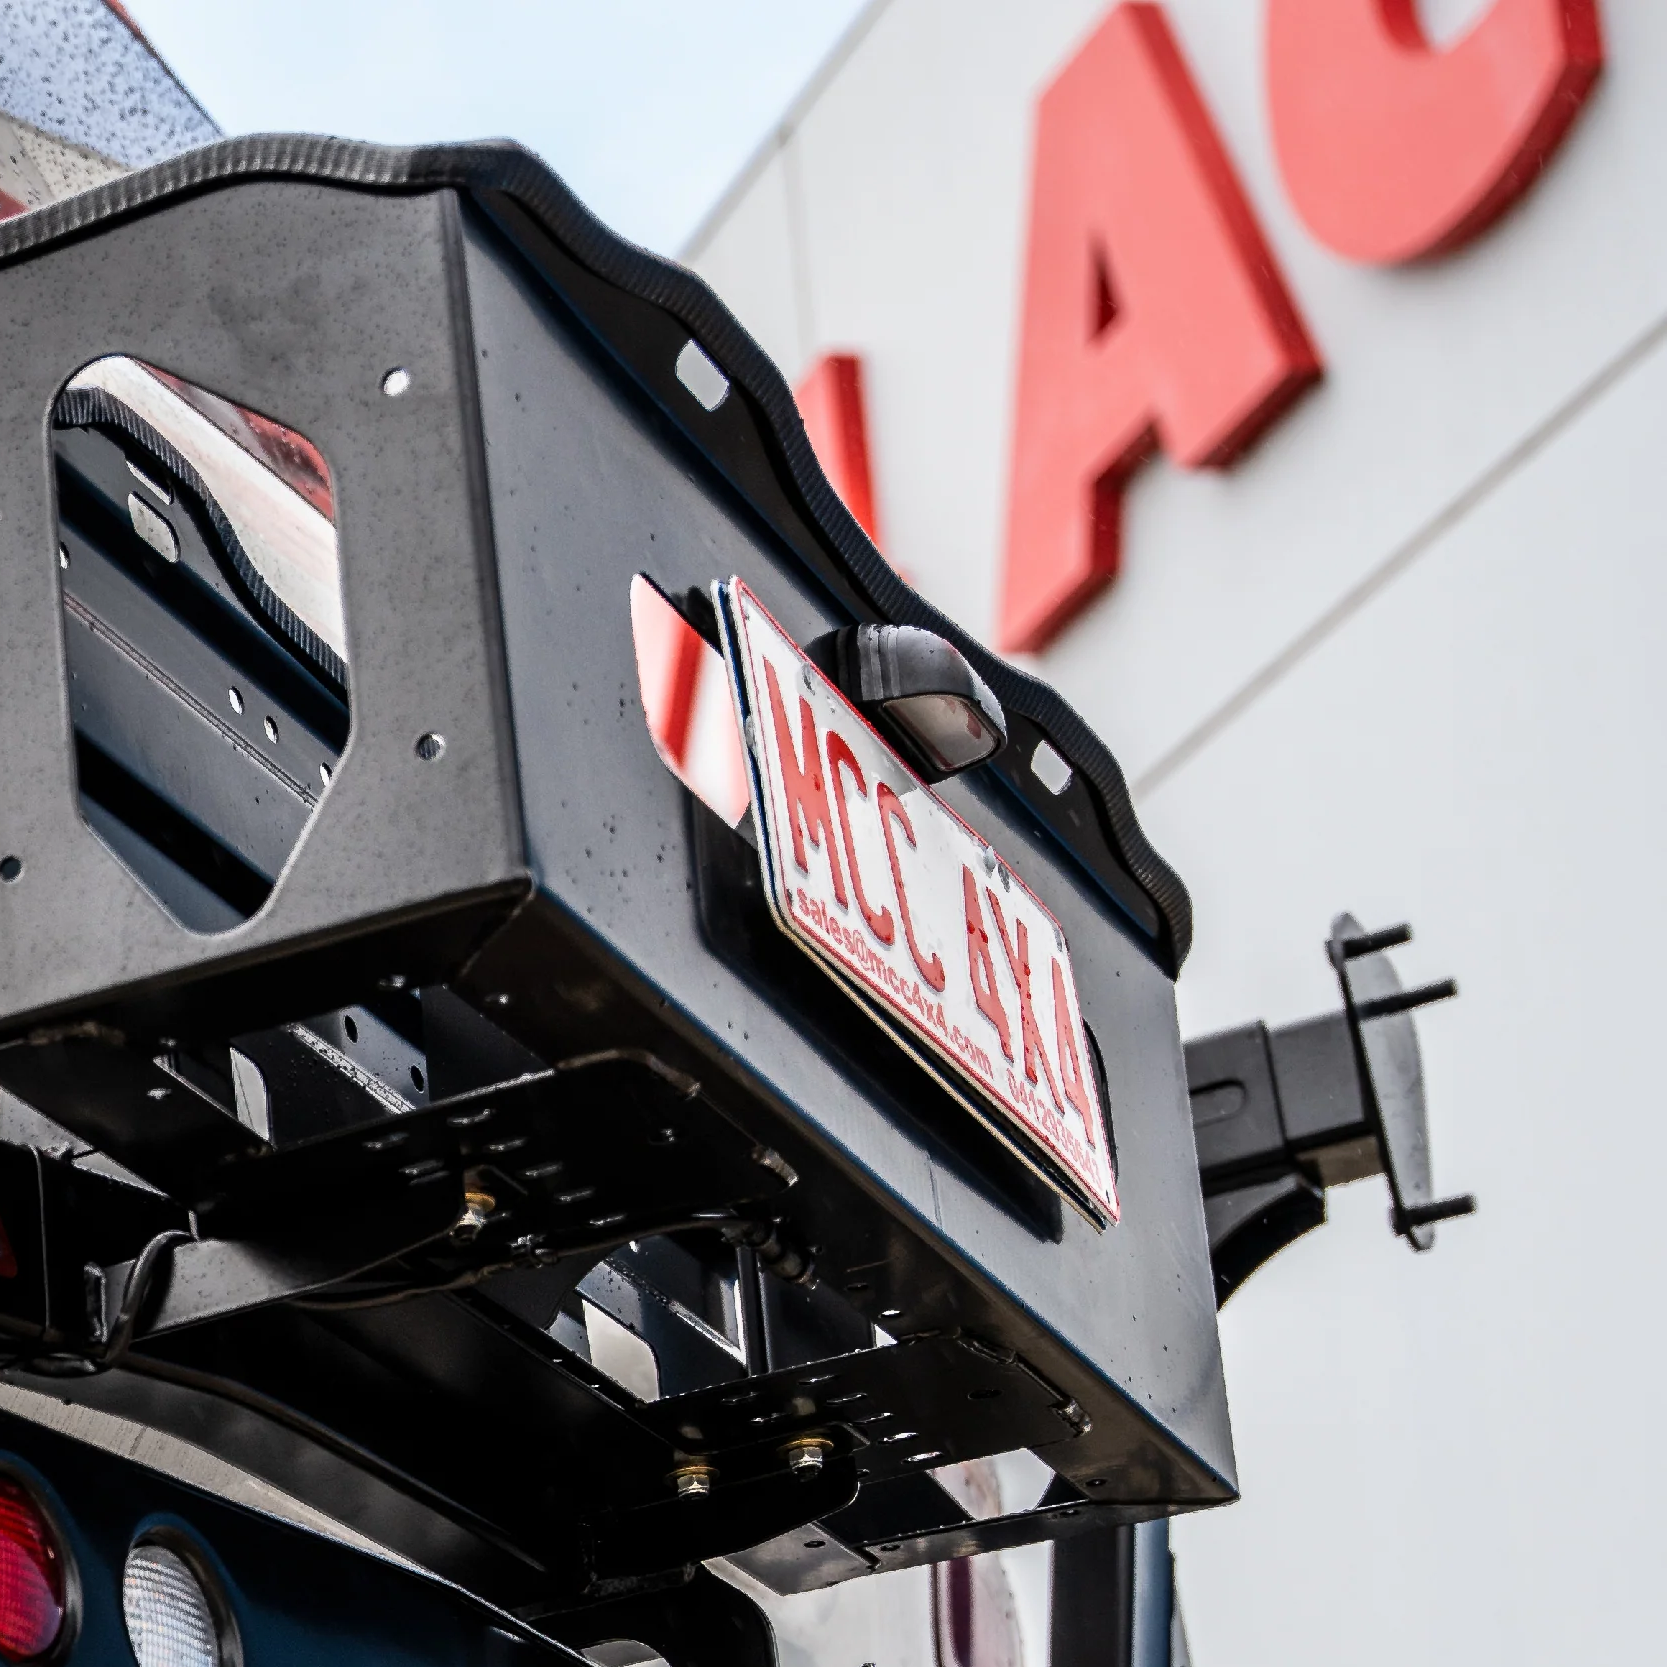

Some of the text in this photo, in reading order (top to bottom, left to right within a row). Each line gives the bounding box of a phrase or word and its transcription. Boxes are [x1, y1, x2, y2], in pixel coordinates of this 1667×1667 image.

[762, 655, 1096, 1149] MCC 4X4
[796, 887, 994, 1080] sales@mcc4x4.com
